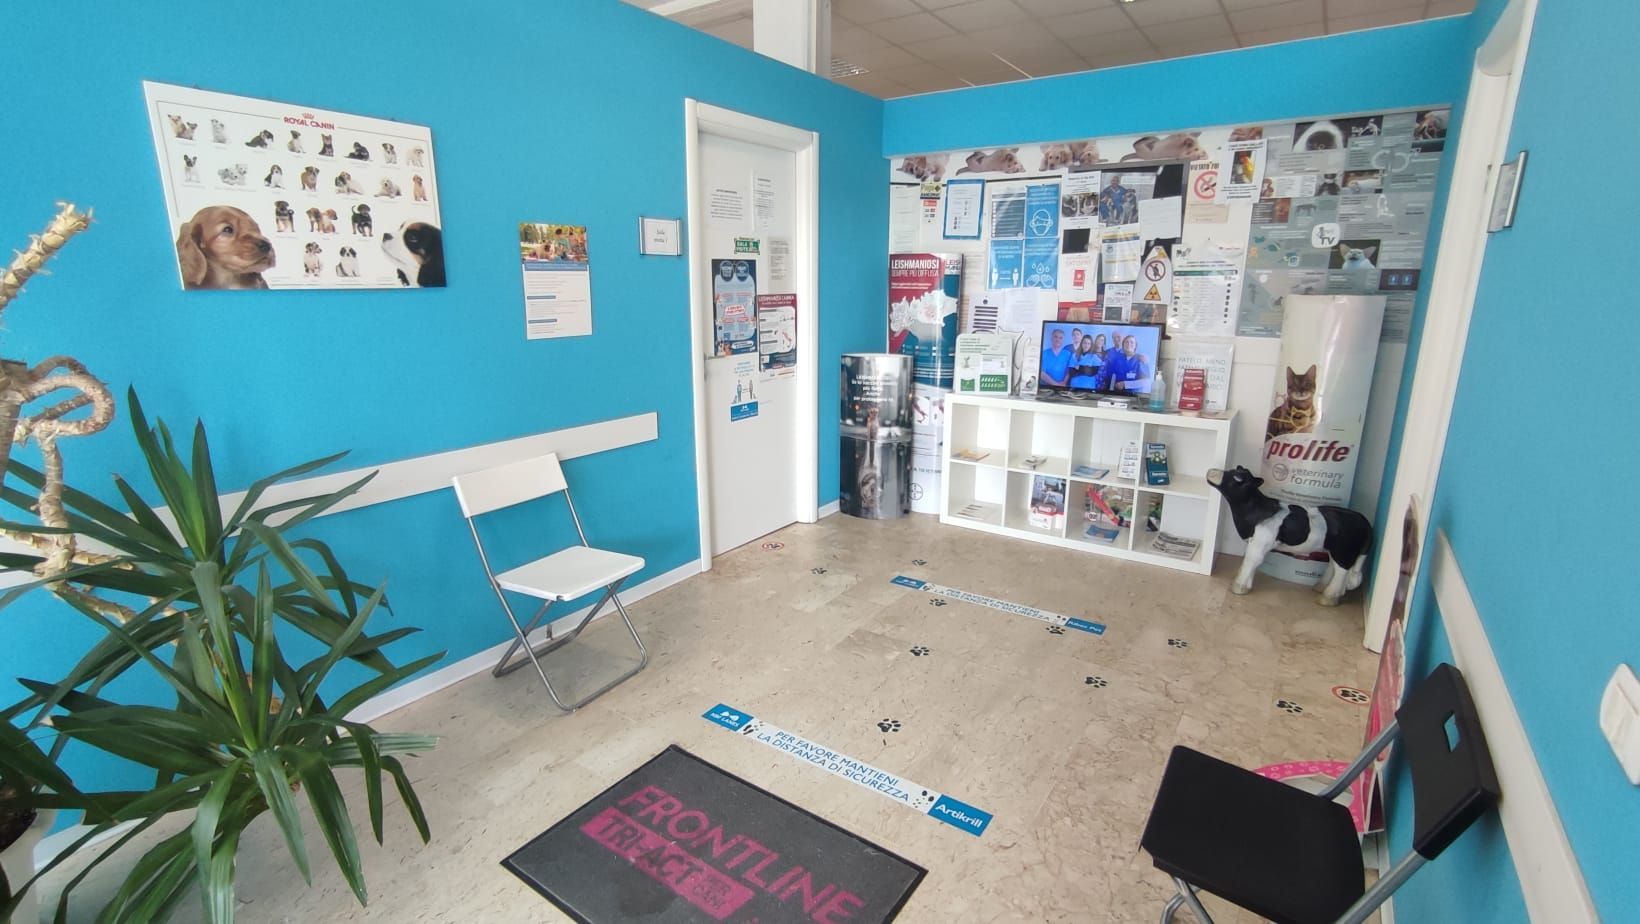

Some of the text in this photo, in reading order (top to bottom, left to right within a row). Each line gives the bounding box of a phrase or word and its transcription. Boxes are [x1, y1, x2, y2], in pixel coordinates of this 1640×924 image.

[283, 116, 335, 130] ROYAL CANIN
[1266, 438, 1350, 462] prolife
[1290, 467, 1344, 480] veterinary
[1290, 474, 1342, 488] formula
[757, 732, 910, 802] LA DISTANZA DI SICUREZZA
[774, 731, 900, 786] PER FAVORE MANTIENI
[935, 803, 983, 829] Artikrill
[619, 785, 865, 924] FRONTLINE
